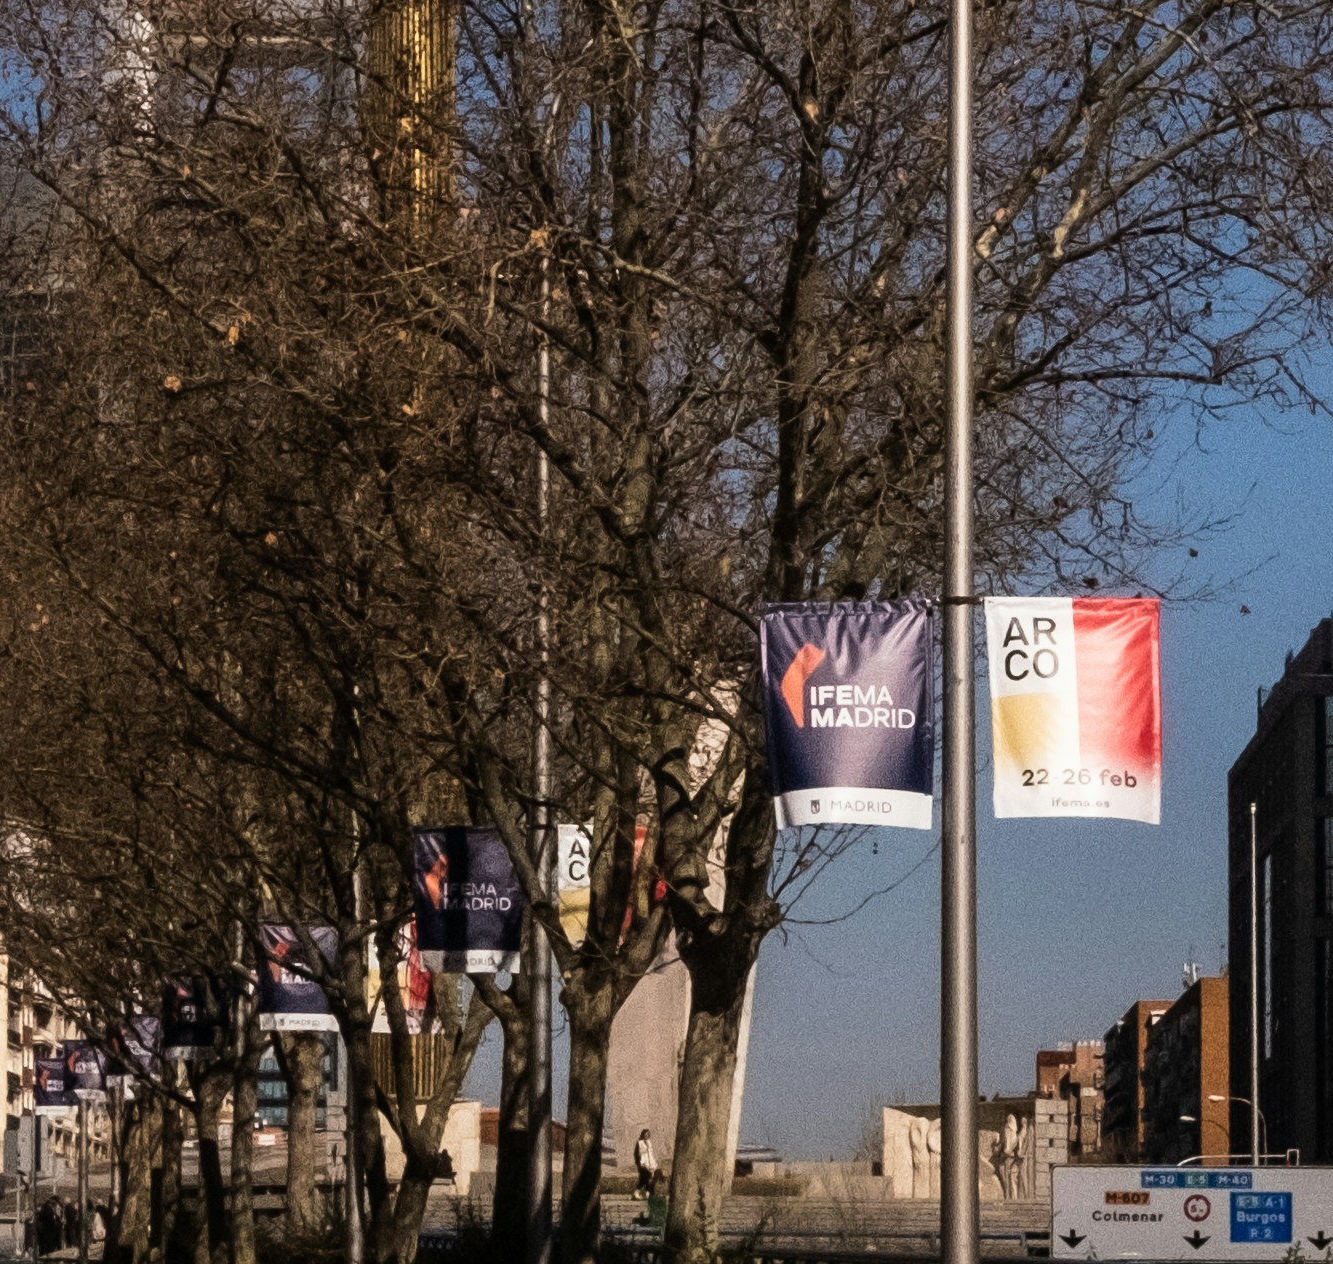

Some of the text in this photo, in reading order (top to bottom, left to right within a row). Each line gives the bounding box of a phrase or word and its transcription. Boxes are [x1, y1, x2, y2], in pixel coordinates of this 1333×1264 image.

[1003, 617, 1056, 647] AR
[1004, 649, 1059, 681] CO
[810, 685, 893, 706] IFEMA
[811, 707, 916, 729] MADRID
[1021, 768, 1049, 786] 22
[1099, 768, 1137, 788] feb
[830, 799, 893, 814] MADRID
[569, 839, 586, 858] A
[568, 860, 585, 881] C
[443, 897, 512, 911] MADRID
[1145, 1175, 1175, 1184] M-30
[1105, 1192, 1150, 1204] M-607
[1092, 1210, 1164, 1222] Colmenar
[1237, 1211, 1285, 1224] Burgos
